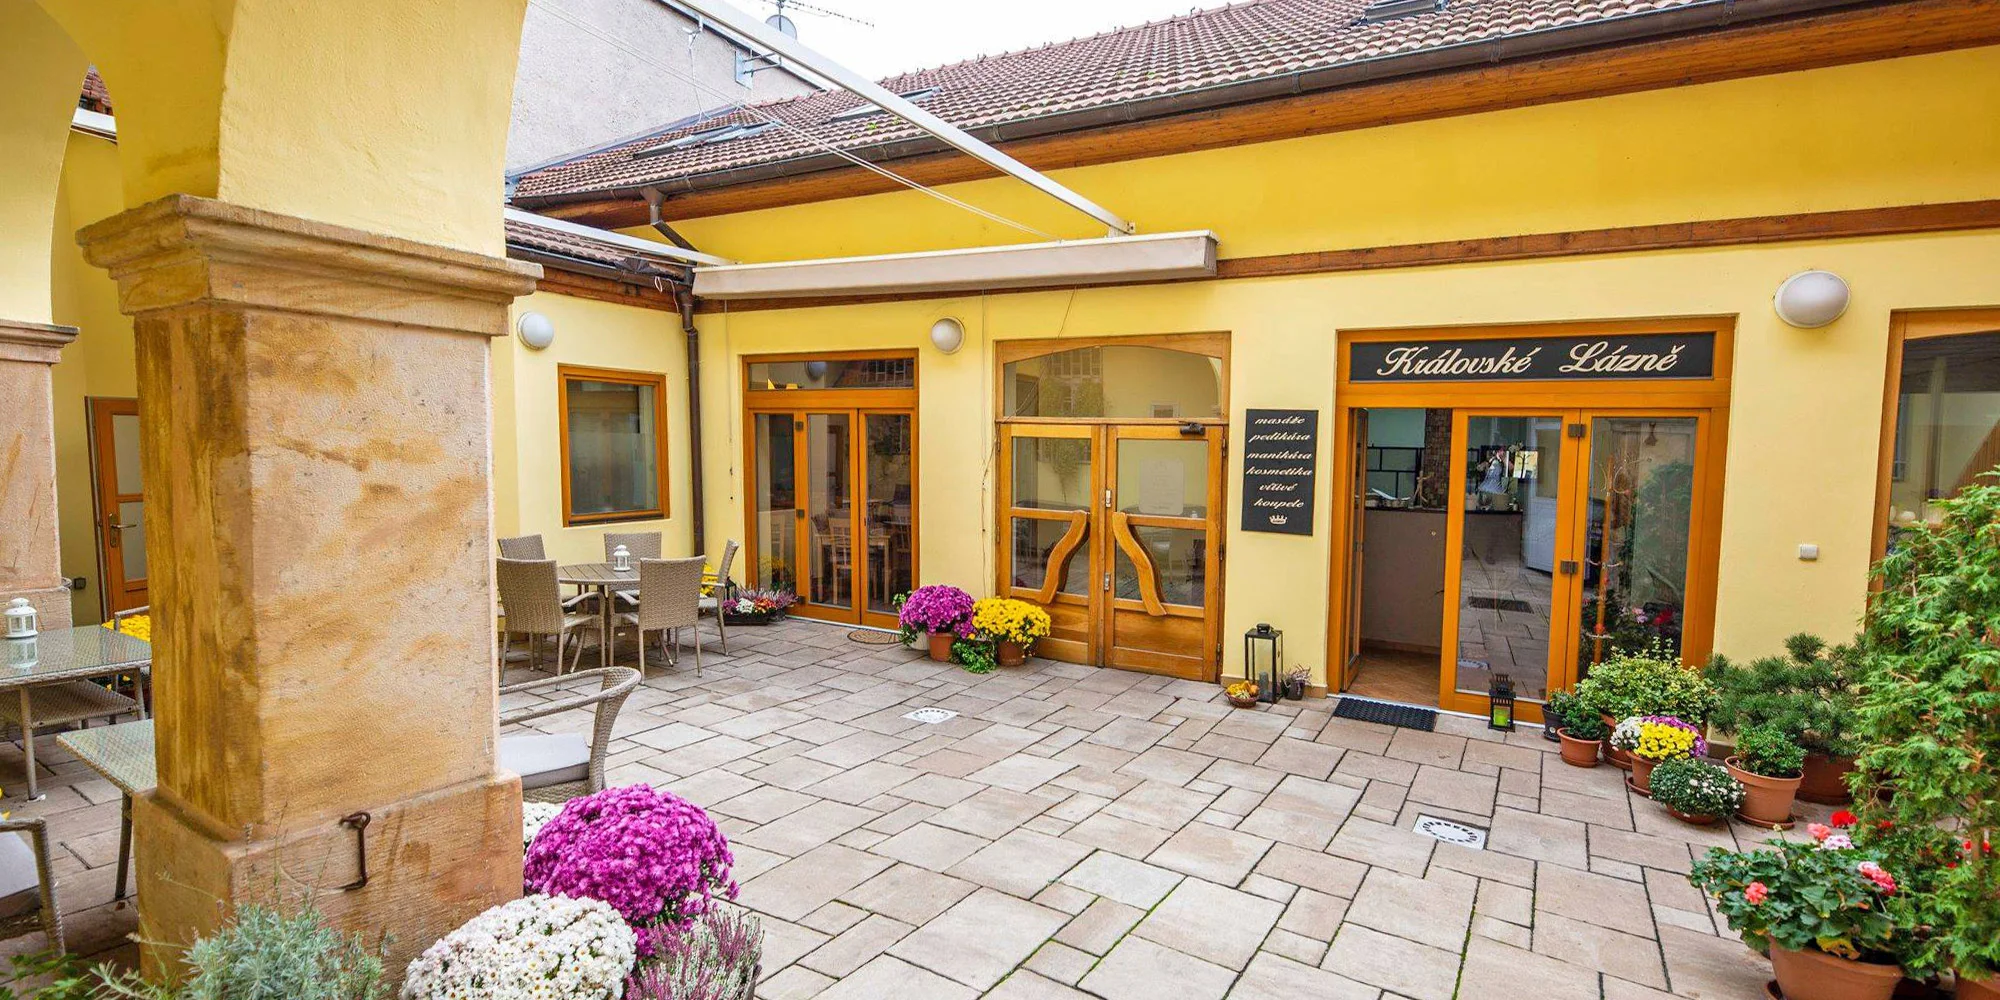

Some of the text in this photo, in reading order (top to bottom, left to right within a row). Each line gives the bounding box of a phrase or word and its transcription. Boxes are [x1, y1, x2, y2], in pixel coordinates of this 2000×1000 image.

[1377, 340, 1686, 376] Královské Lázně
[1246, 466, 1313, 476] kosmetika
[1254, 498, 1304, 509] koupele
